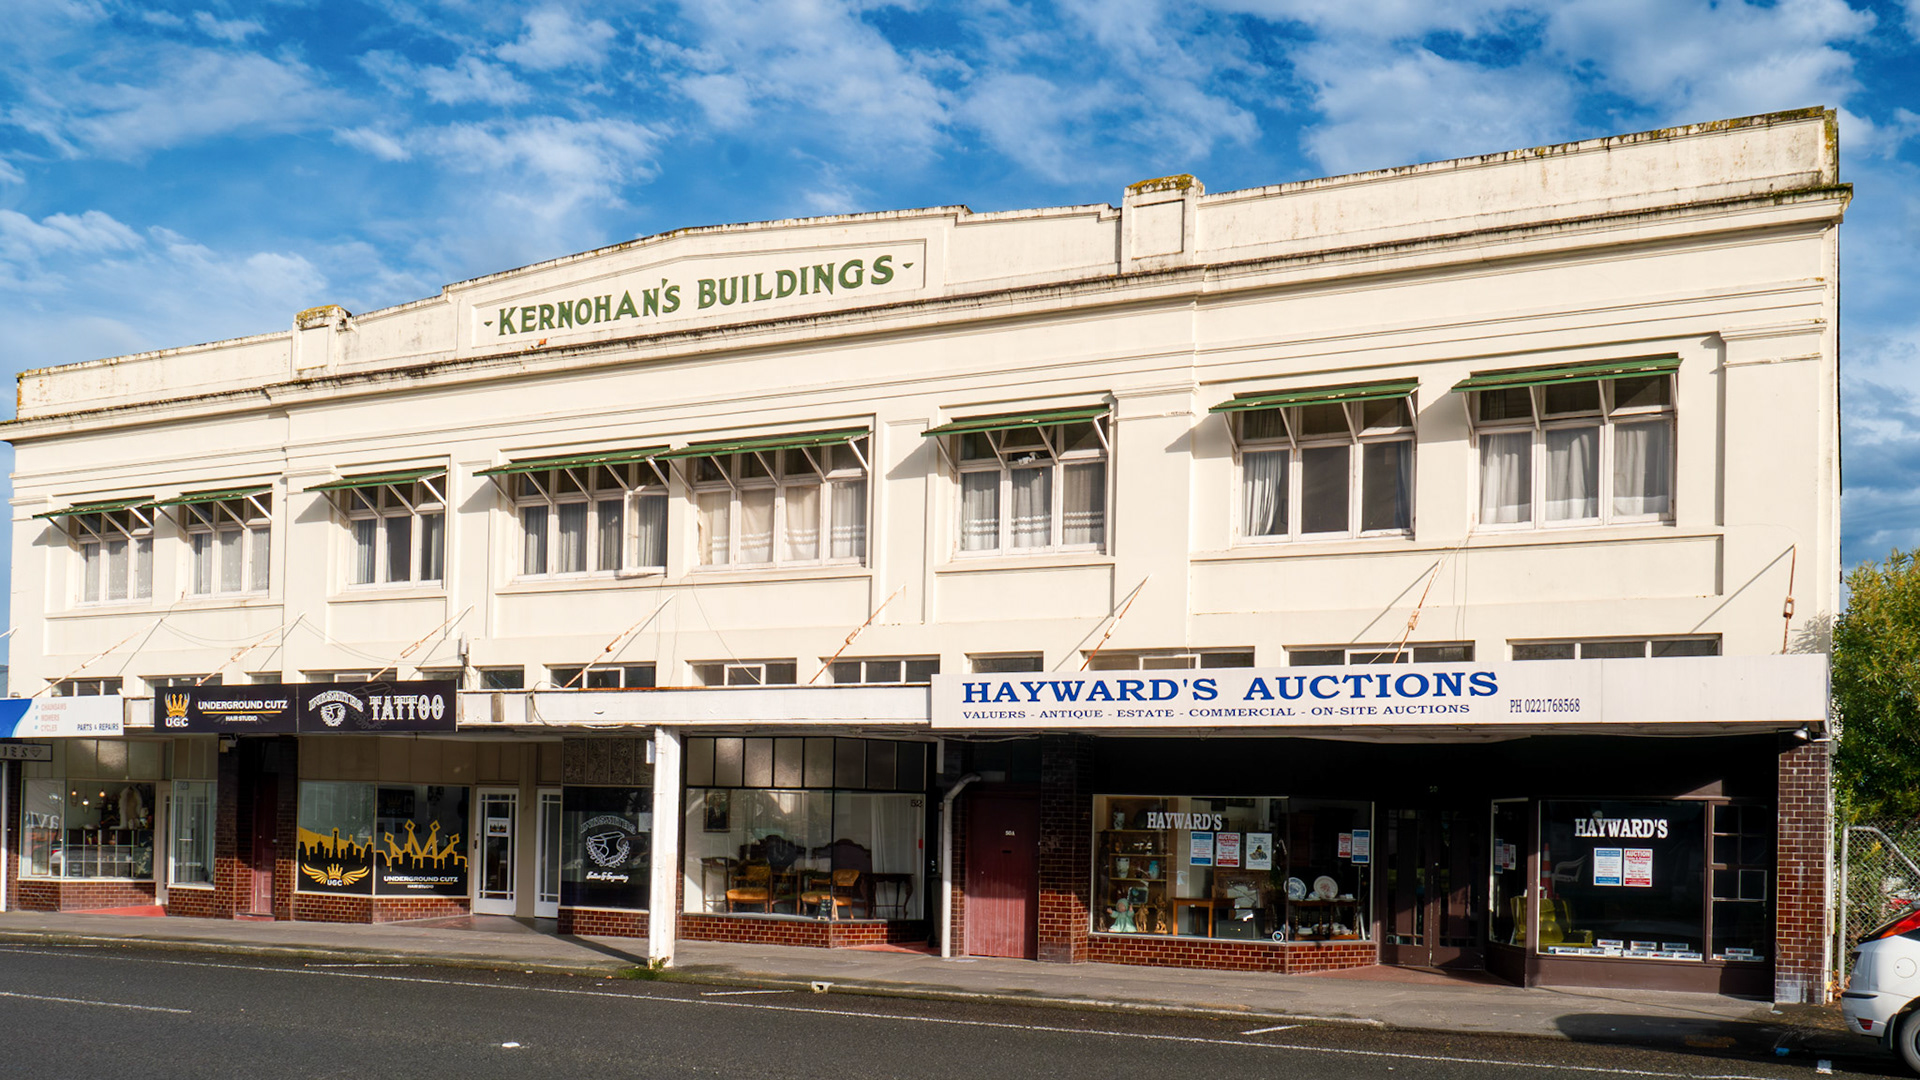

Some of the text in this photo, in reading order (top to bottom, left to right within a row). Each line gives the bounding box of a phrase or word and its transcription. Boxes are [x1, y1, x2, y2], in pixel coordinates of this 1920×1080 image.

[498, 255, 895, 336] KERNOHAN'S BUILDINGS
[962, 672, 1499, 703] HAYWARD'S AUCTIONS
[41, 703, 67, 711] CHAINSAWS
[198, 699, 288, 710] UNDERGROUND CUTZ
[369, 694, 446, 720] TATTOO
[963, 710, 1026, 719] VALUERS
[1039, 709, 1103, 720] ANTIQUE
[1116, 708, 1175, 718] ESTATE
[1189, 706, 1296, 718] COMMERCIAL
[1311, 705, 1378, 716] ON-SITE
[1383, 704, 1470, 715] AUCTIONS
[1510, 698, 1581, 713] PH 0221768568
[41, 724, 58, 732] CYCLES
[77, 723, 92, 731] PARTS
[98, 723, 119, 731] REPAIRS
[165, 717, 189, 728] UGC
[1147, 812, 1222, 831] HAYWARD'S
[1575, 818, 1668, 839] HAYWARD'S
[326, 879, 343, 887] UGC
